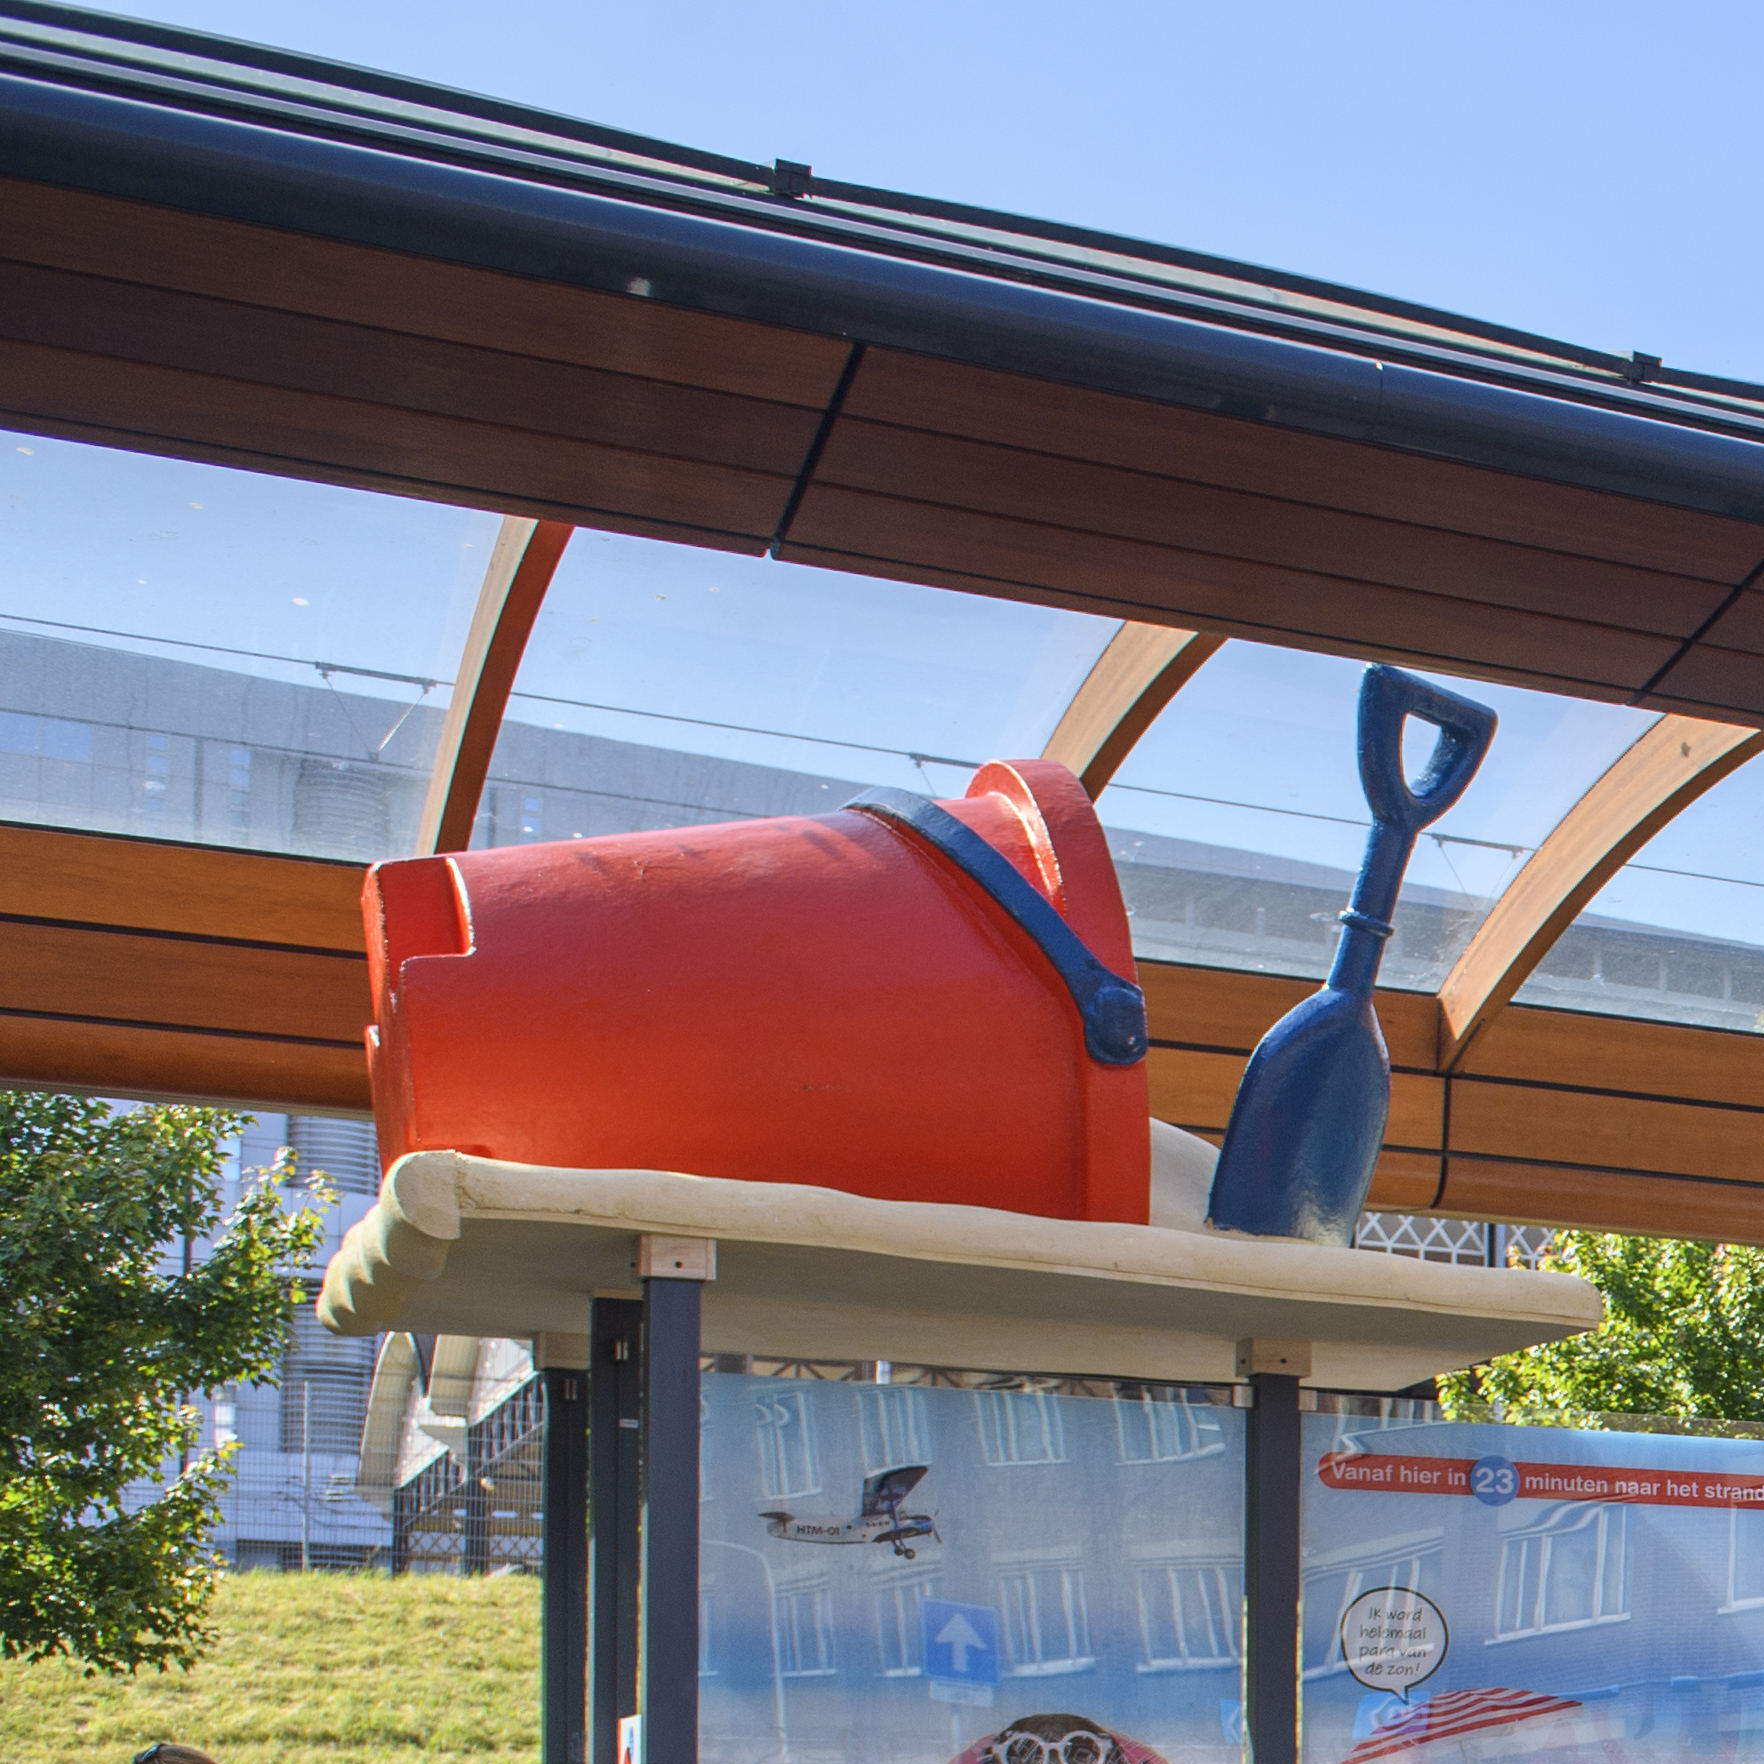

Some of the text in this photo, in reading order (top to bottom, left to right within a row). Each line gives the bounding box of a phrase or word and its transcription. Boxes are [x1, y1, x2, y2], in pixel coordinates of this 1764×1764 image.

[1331, 1461, 1393, 1482] Vanaf
[1400, 1466, 1441, 1485] hier
[1448, 1468, 1466, 1486] in
[1474, 1466, 1514, 1495] 23
[1525, 1473, 1608, 1494] minuten
[1614, 1480, 1661, 1496] naar
[1666, 1479, 1699, 1498] het
[1359, 1624, 1427, 1640] helemaal
[1400, 1648, 1427, 1658] van
[1365, 1661, 1421, 1676] de zon!
